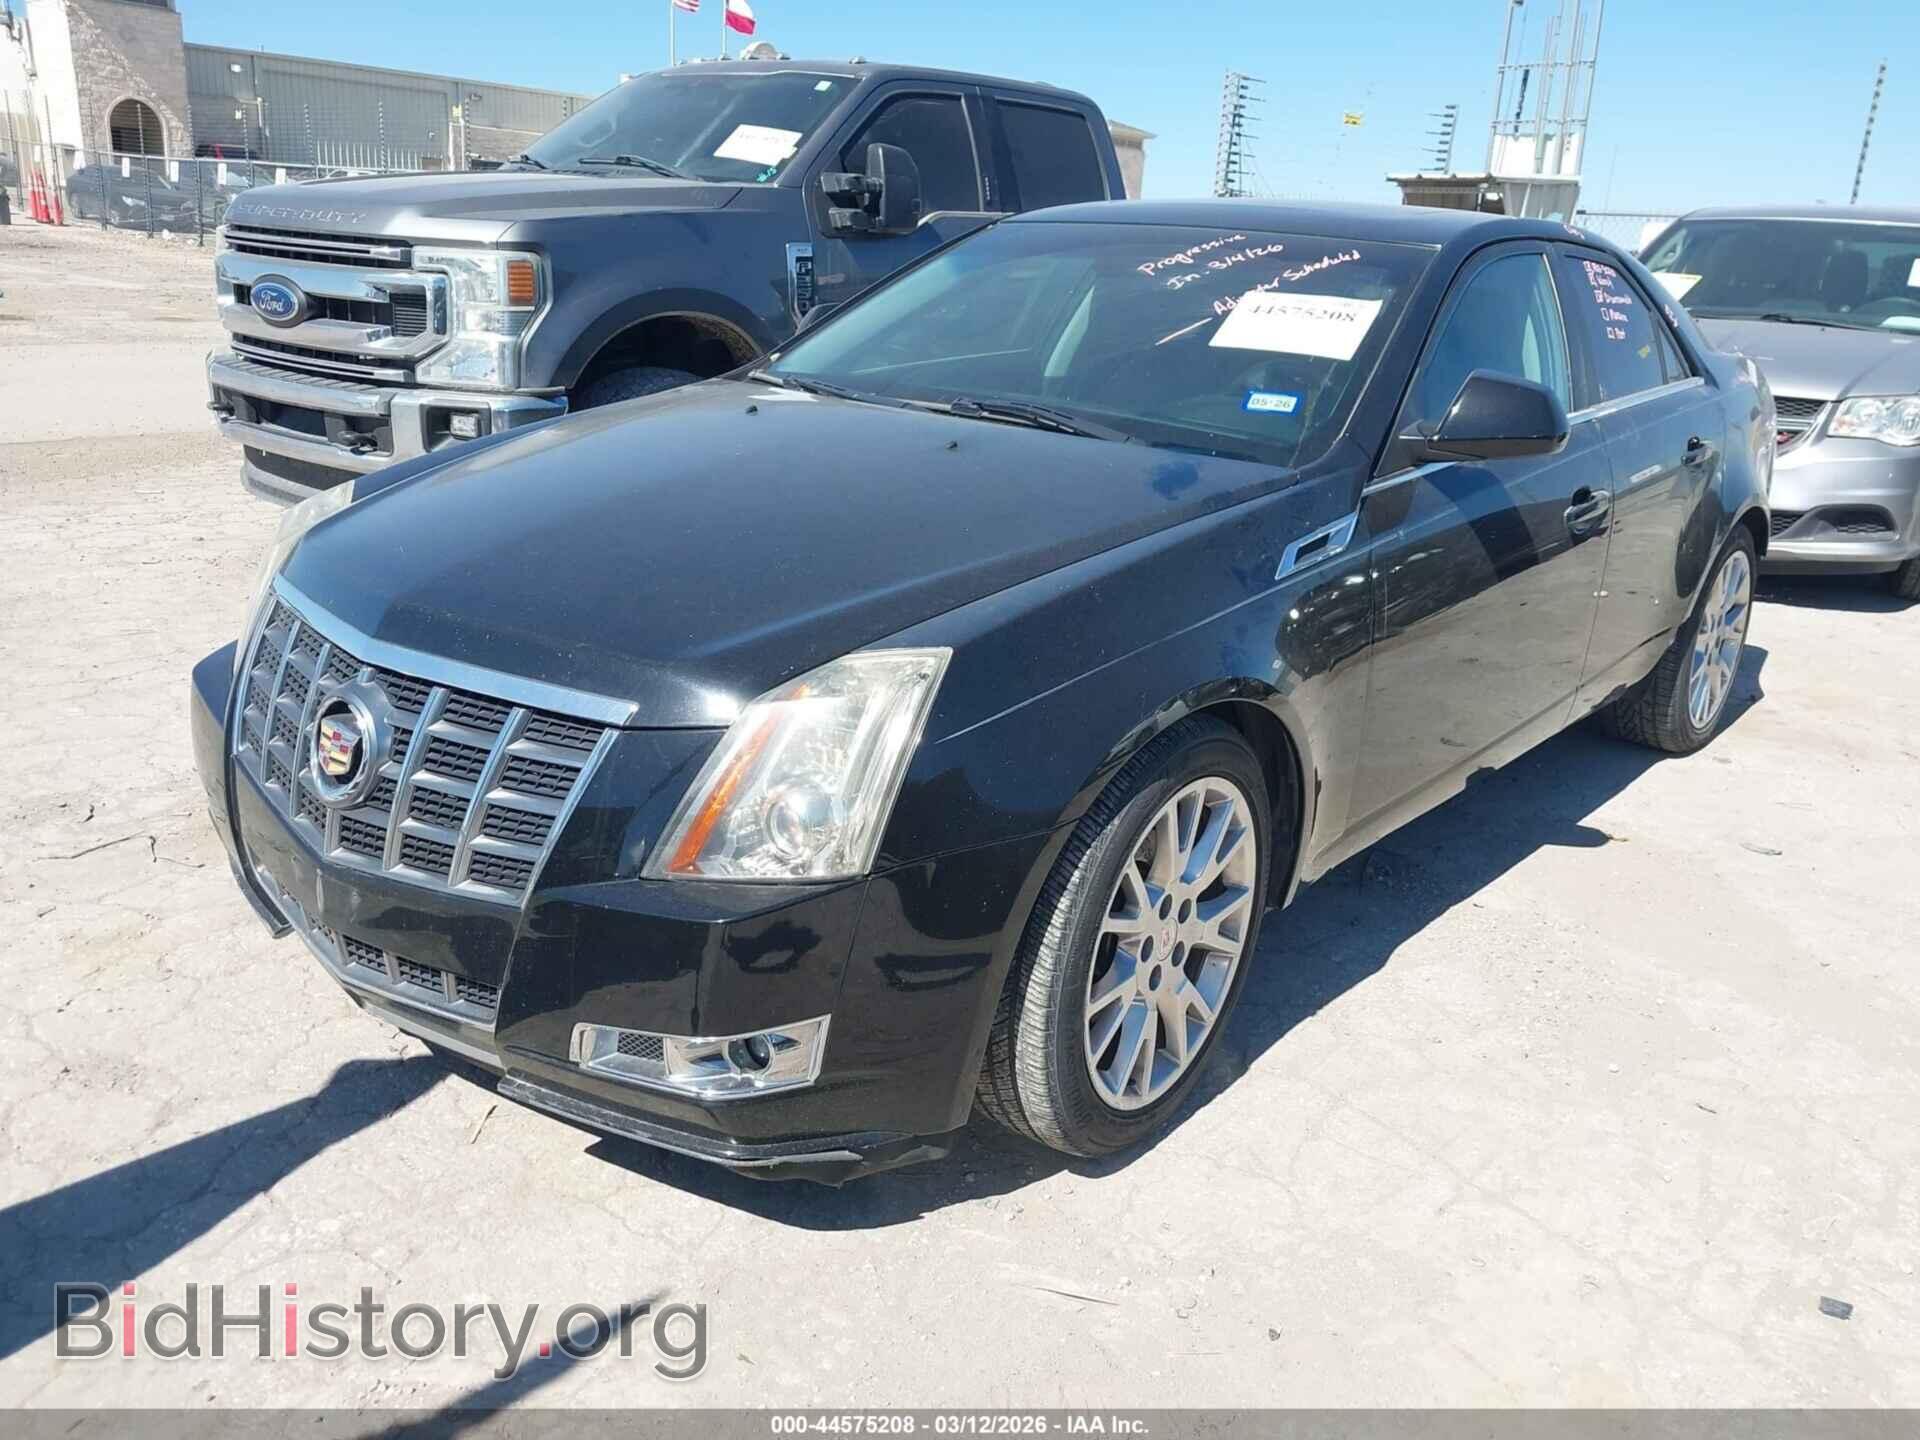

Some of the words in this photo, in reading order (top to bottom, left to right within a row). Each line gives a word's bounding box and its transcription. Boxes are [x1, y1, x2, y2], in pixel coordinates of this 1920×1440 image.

[1137, 234, 1247, 276] Progressive
[1282, 249, 1361, 281] Scheduled
[260, 290, 284, 311] Ford
